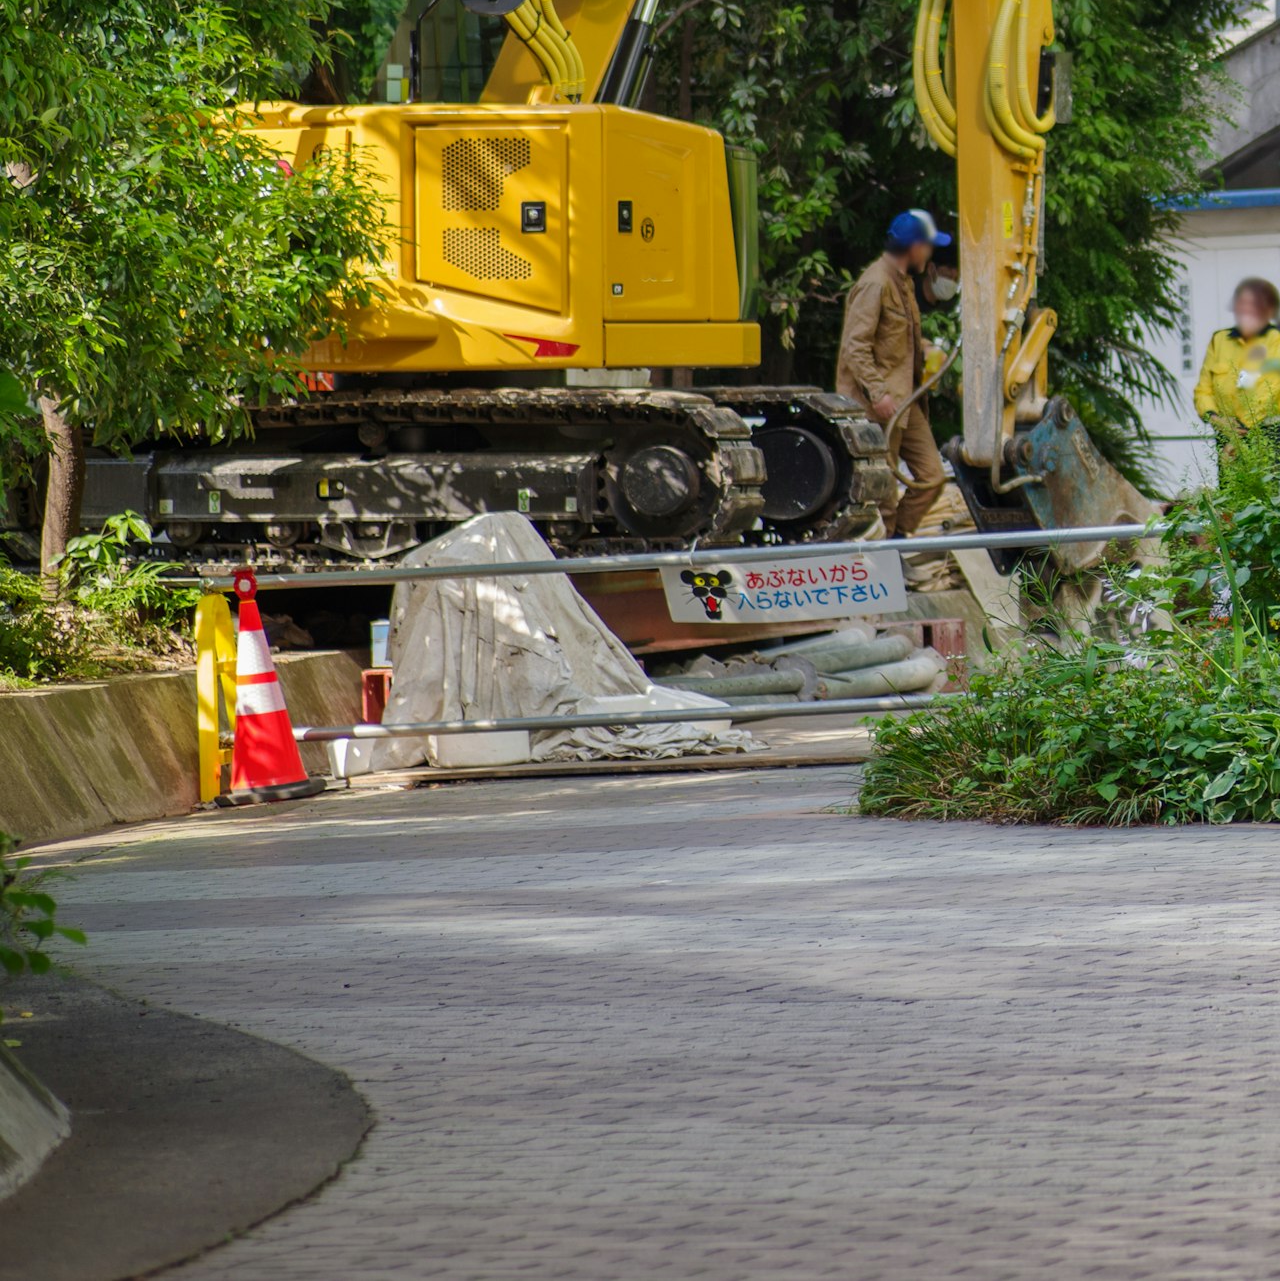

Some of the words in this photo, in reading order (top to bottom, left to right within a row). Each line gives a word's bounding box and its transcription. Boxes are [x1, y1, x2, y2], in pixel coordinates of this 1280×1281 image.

[745, 562, 868, 589] あぶないから
[738, 583, 888, 610] 入らないで下さい
